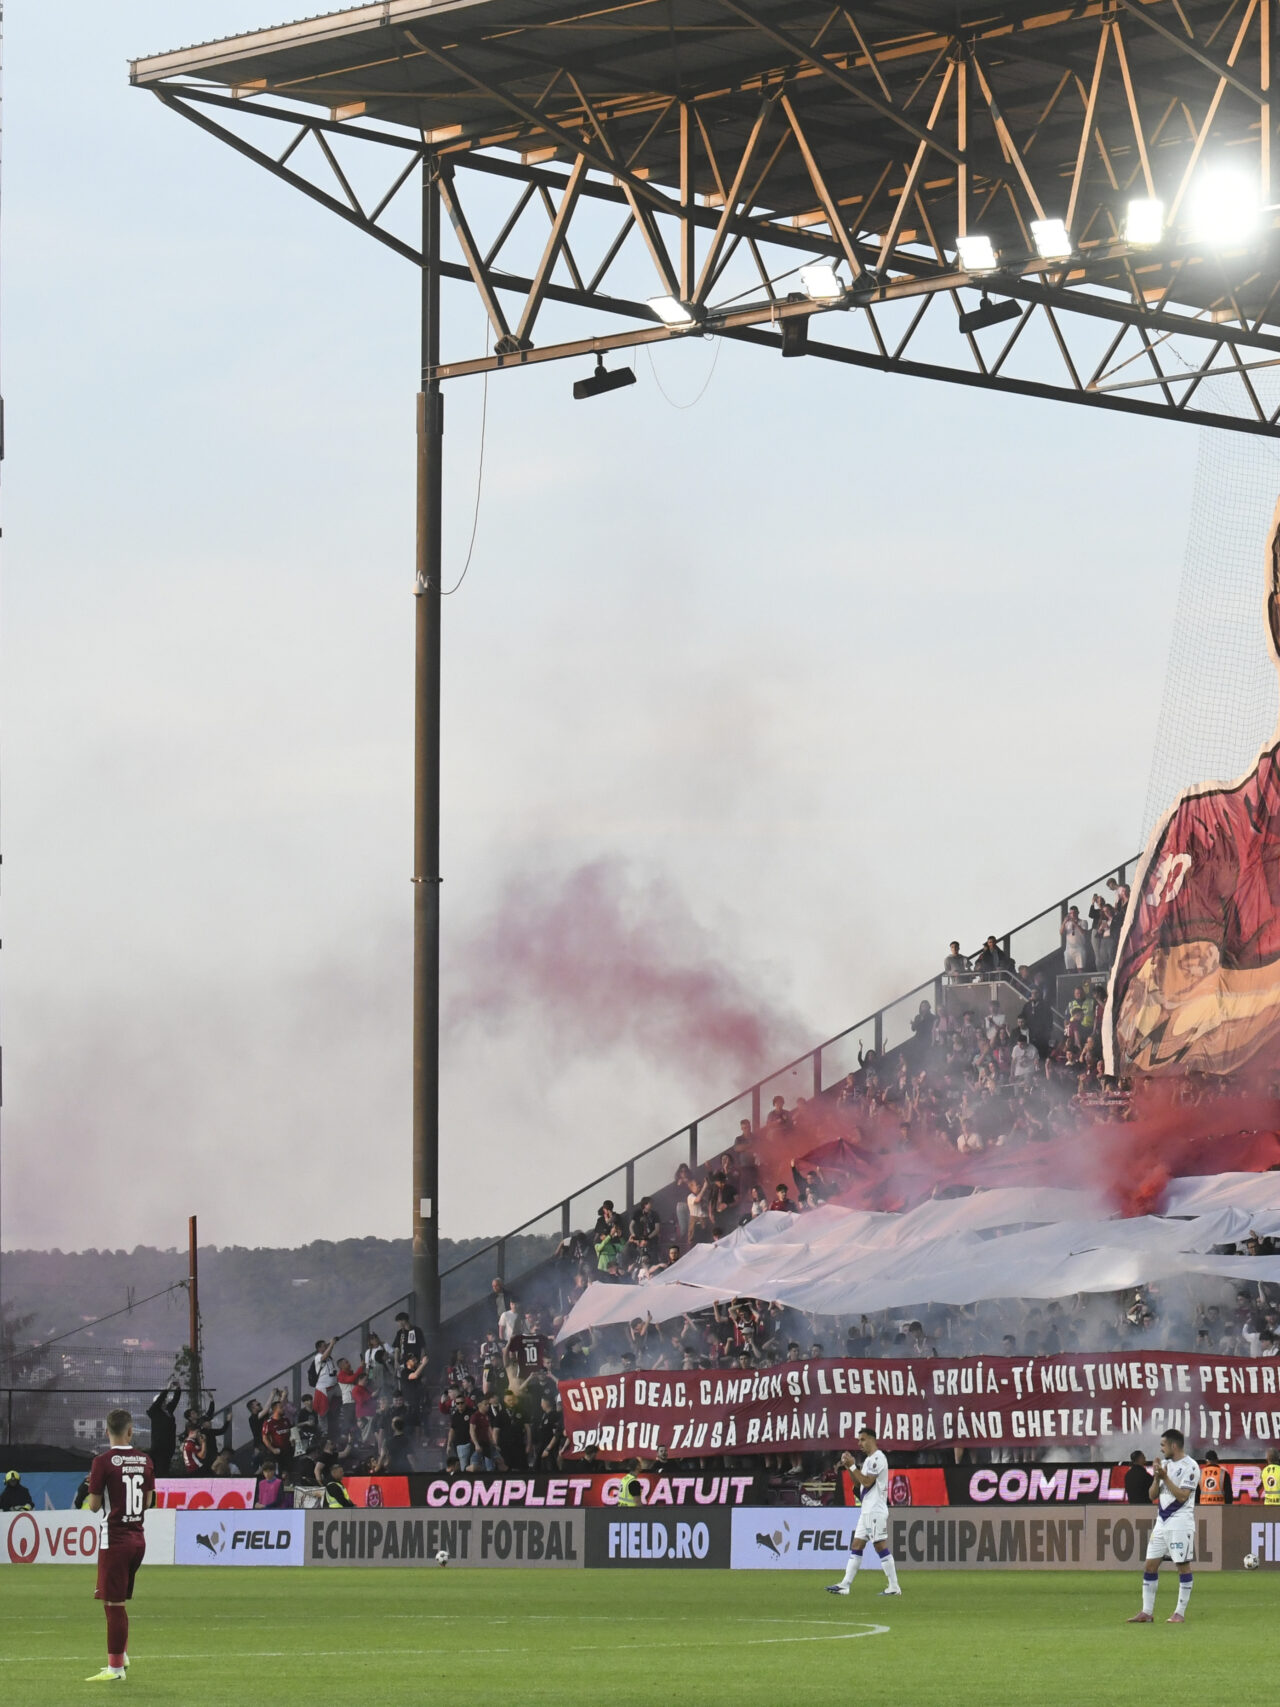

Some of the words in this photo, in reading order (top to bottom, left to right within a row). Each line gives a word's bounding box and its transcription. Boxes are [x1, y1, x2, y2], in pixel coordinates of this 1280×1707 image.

[839, 1411, 867, 1438] PE
[1012, 1407, 1113, 1438] GHETELE
[122, 1475, 144, 1516] 16
[427, 1480, 591, 1506] COMPLET
[231, 1530, 291, 1550] FIELD
[311, 1520, 471, 1560] ECHIPAMENT
[481, 1520, 577, 1560] FOTBAL
[608, 1521, 710, 1559] FIELD.RO
[897, 1519, 1086, 1562] ECHIPAMENT
[1096, 1518, 1213, 1562] FOTL
